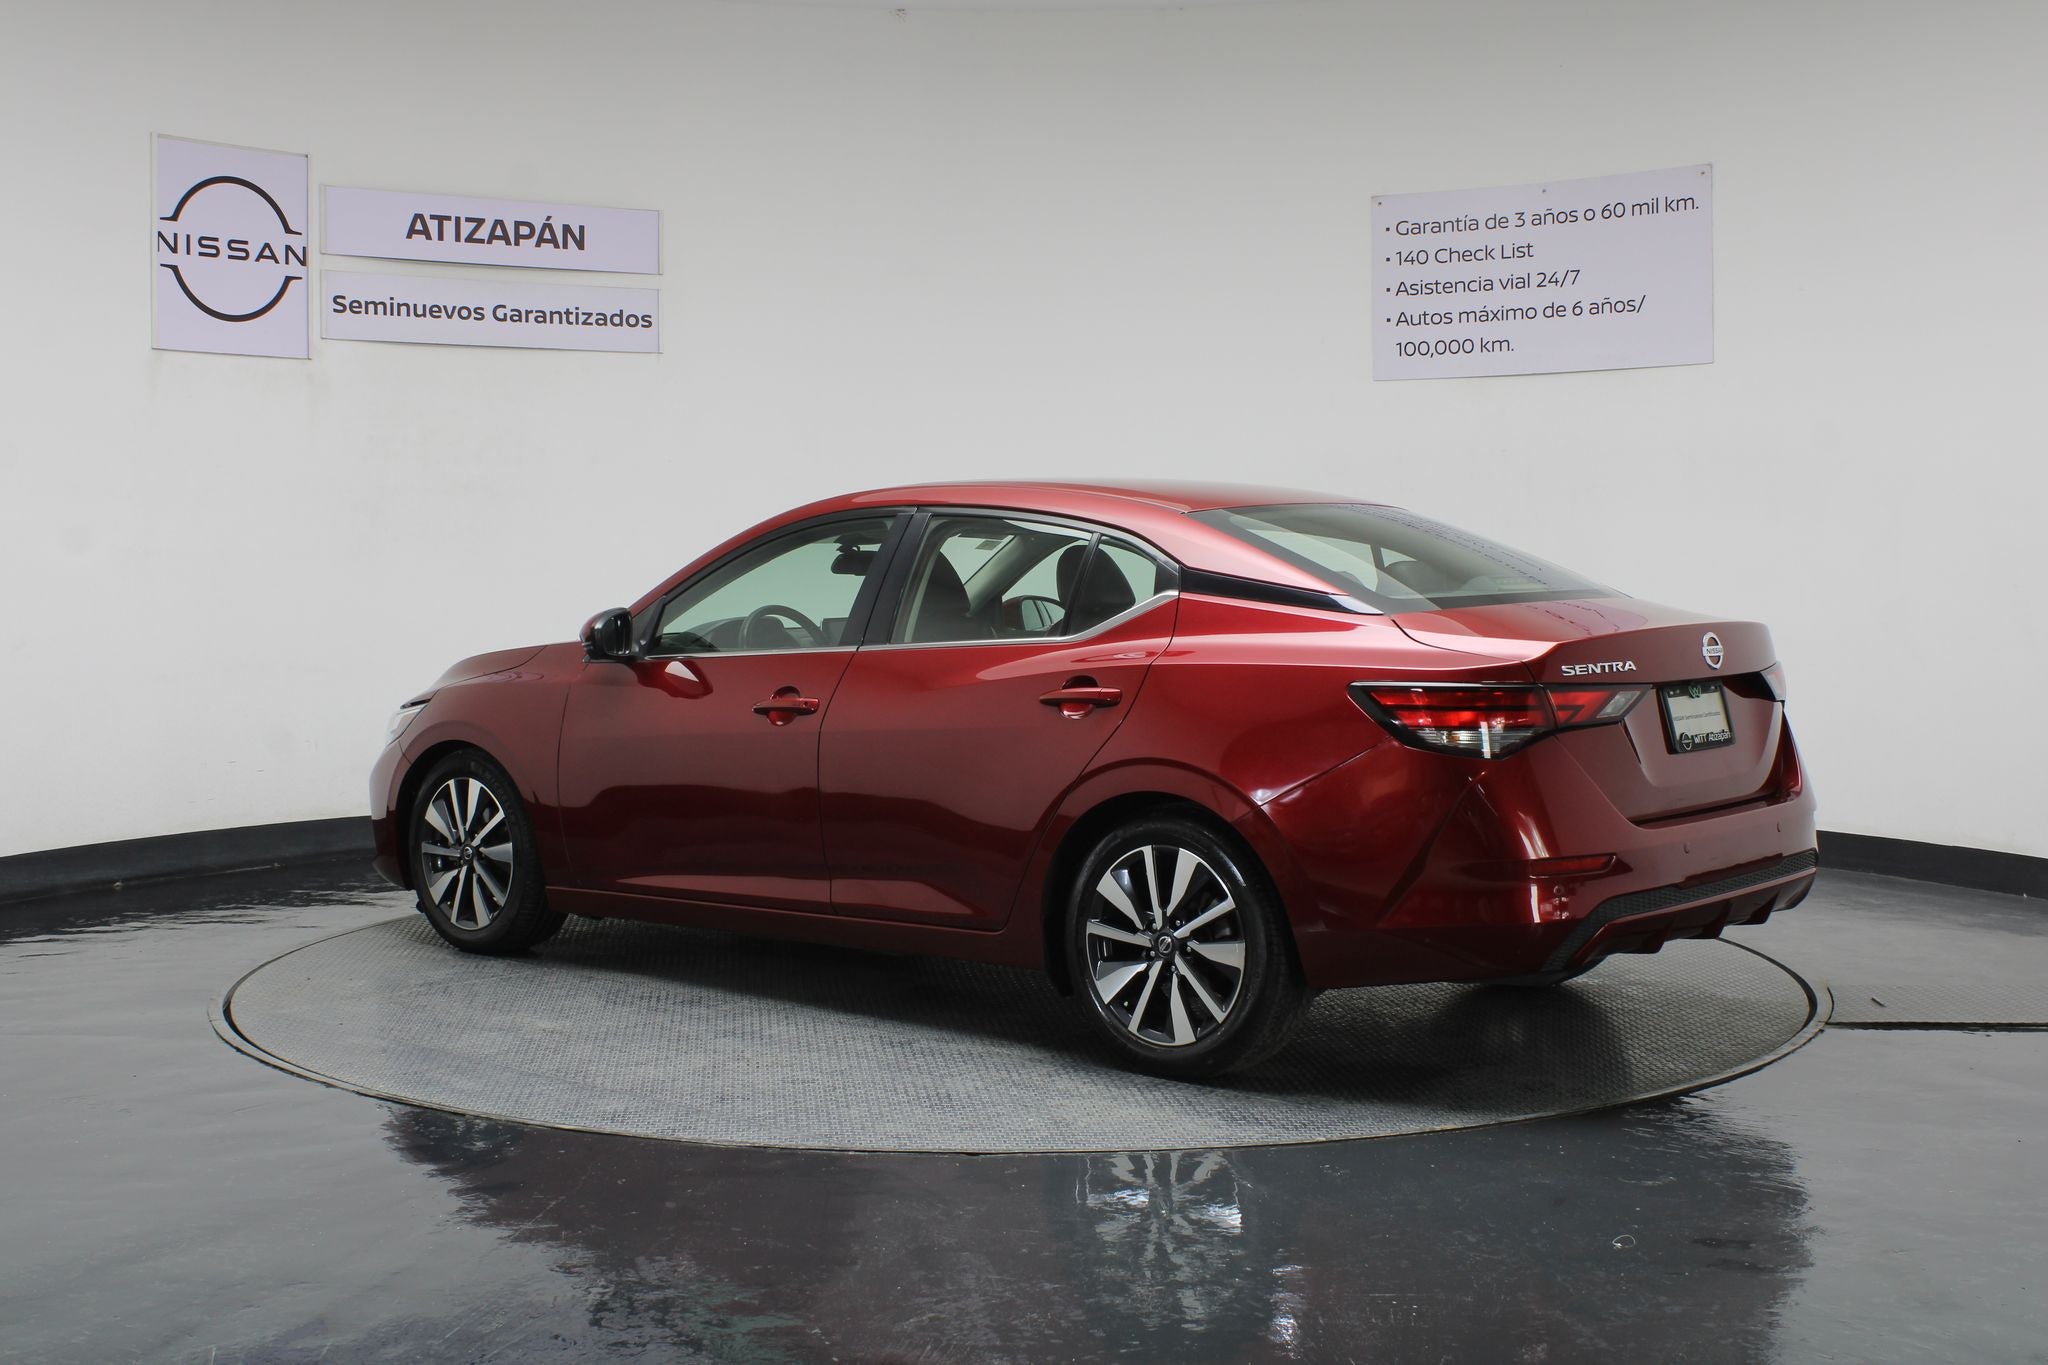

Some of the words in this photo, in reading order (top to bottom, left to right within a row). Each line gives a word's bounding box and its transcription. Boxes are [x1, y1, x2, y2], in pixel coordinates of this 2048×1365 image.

[405, 212, 586, 251] ATIZAPÁN
[1395, 214, 1479, 236] Garantía
[1485, 213, 1509, 230] de
[1514, 211, 1526, 228] 3
[1532, 207, 1579, 227] años
[1583, 208, 1596, 222] o
[1601, 201, 1626, 220] 60
[1631, 196, 1659, 217] mil
[1665, 195, 1699, 213] km.
[157, 230, 308, 267] NISSAN
[1395, 249, 1429, 266] 140
[1434, 244, 1496, 264] Check
[1501, 242, 1535, 261] List
[1395, 275, 1494, 297] Asistencia
[1499, 272, 1531, 290] vial
[1537, 269, 1581, 288] 24/7
[332, 294, 486, 323] Seminuevos
[492, 304, 653, 329] Garantizados
[1395, 310, 1453, 327] Autos
[1458, 304, 1537, 324] máximo
[1542, 301, 1567, 319] de
[1571, 300, 1584, 317] 6
[1588, 294, 1647, 316] años/
[1395, 338, 1475, 359] 100,000
[1480, 337, 1514, 356] km.
[1561, 660, 1637, 676] SENTRA
